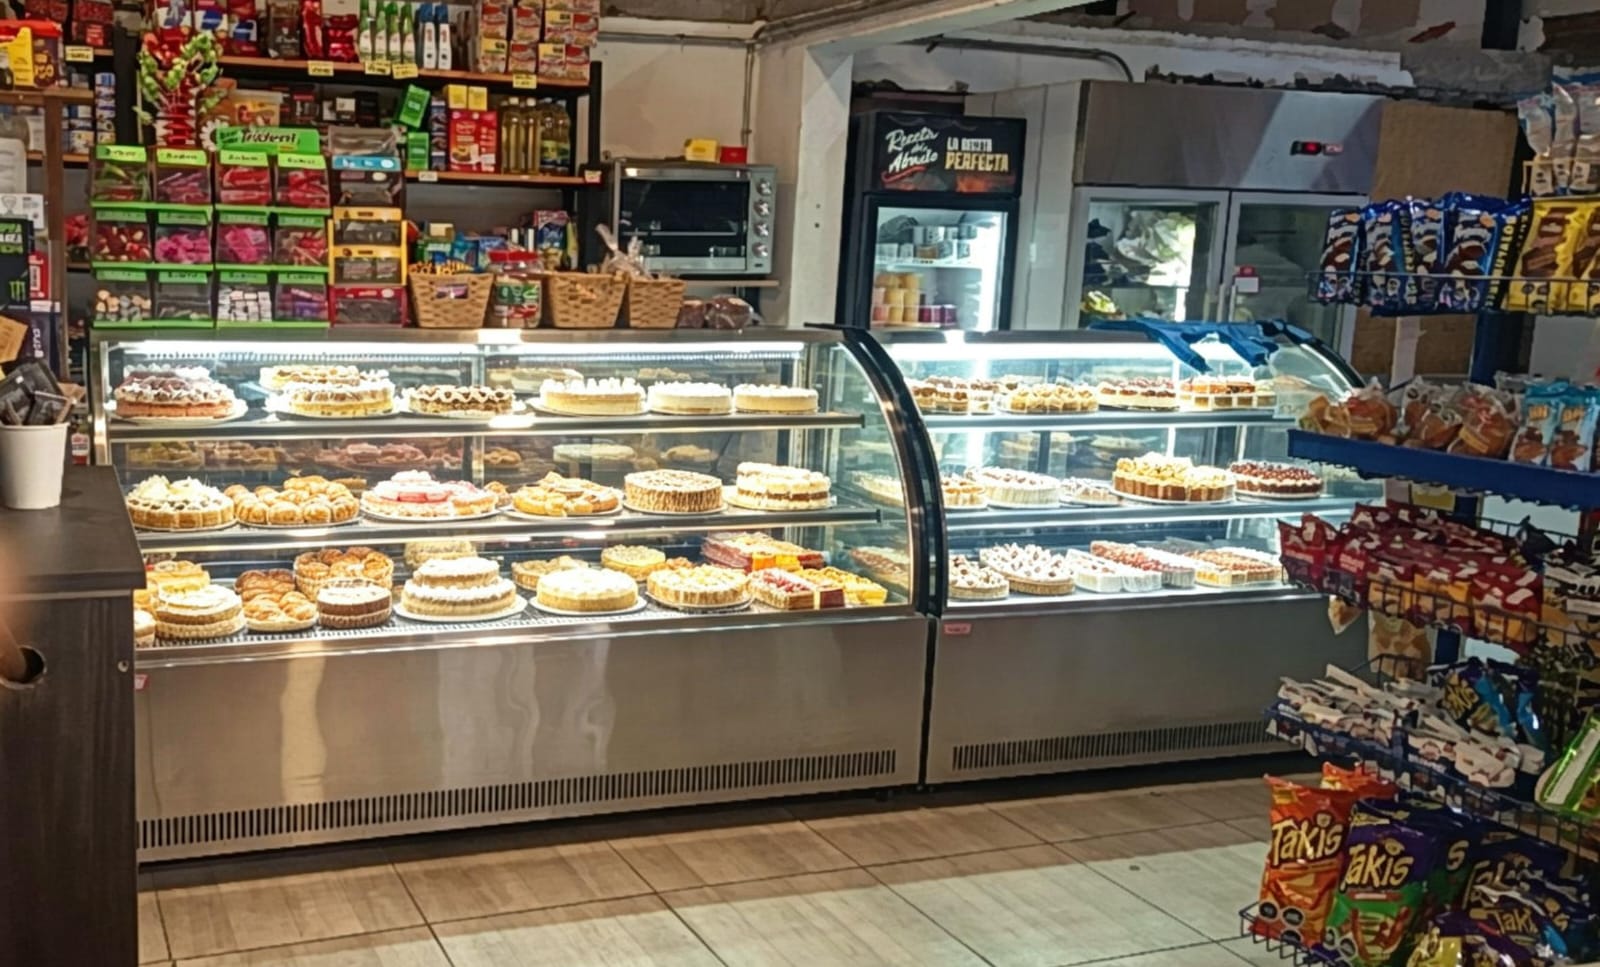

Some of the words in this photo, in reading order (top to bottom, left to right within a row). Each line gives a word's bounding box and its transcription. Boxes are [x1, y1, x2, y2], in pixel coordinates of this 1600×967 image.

[241, 129, 297, 143] Trident
[945, 152, 1009, 172] PERFECTA
[1272, 812, 1343, 866] Takis
[1341, 838, 1415, 891] Takis
